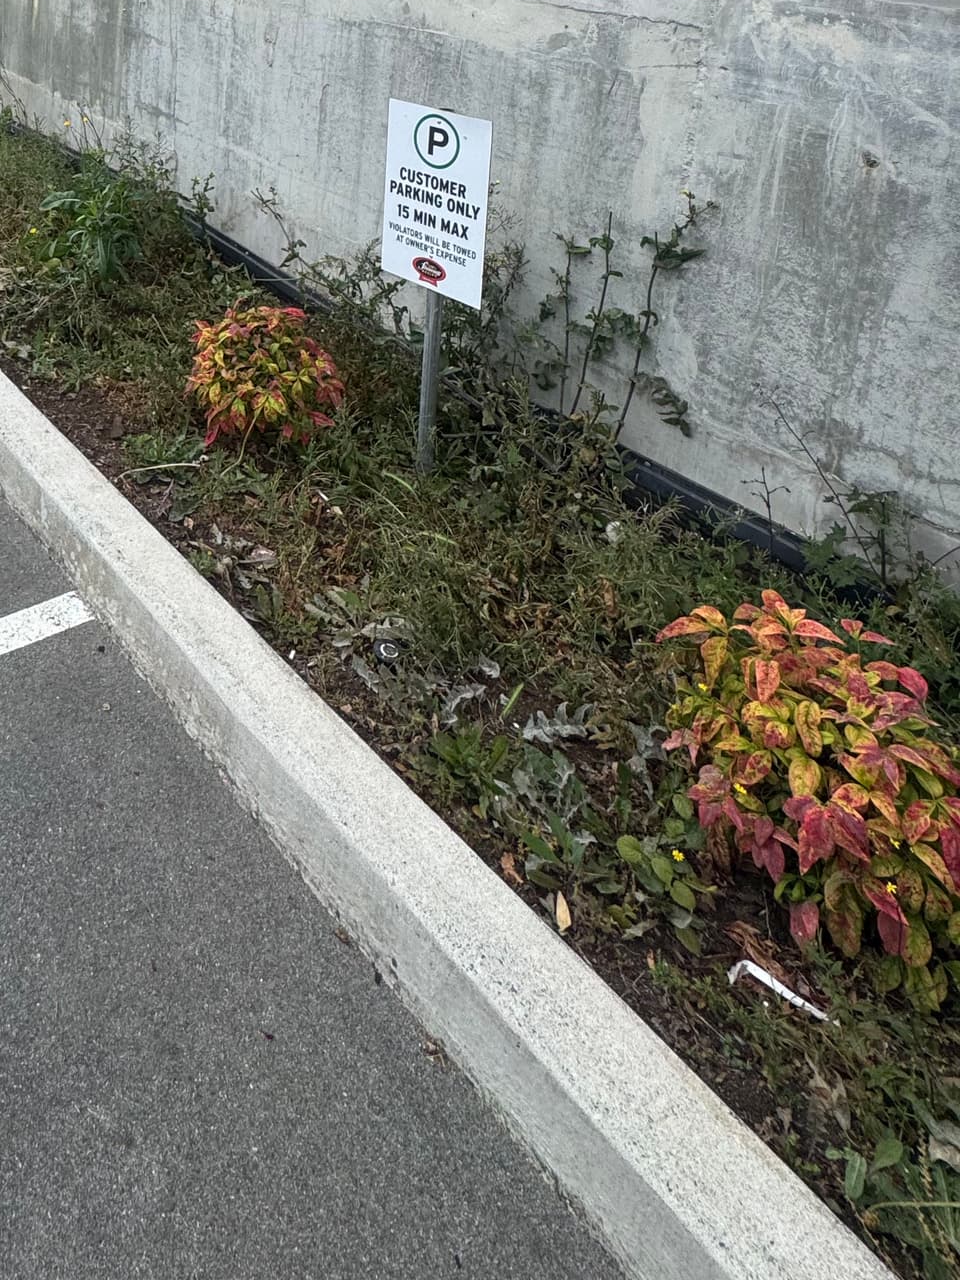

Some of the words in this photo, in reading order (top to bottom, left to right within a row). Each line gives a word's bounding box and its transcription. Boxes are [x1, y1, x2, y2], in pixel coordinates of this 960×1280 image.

[427, 126, 449, 155] P
[390, 180, 442, 208] PARKING
[447, 198, 480, 220] ONLY
[400, 167, 467, 199] CUSTOMER
[398, 204, 409, 219] 15
[414, 209, 436, 229] MIN
[440, 218, 469, 240] MAX
[388, 221, 423, 240] VIOLATORS
[424, 234, 440, 247] WILL
[442, 240, 451, 250] BE
[453, 244, 477, 260] TOWED
[396, 234, 403, 243] AT
[405, 237, 434, 255] OWNER'S
[436, 248, 467, 267] EXPENSE
